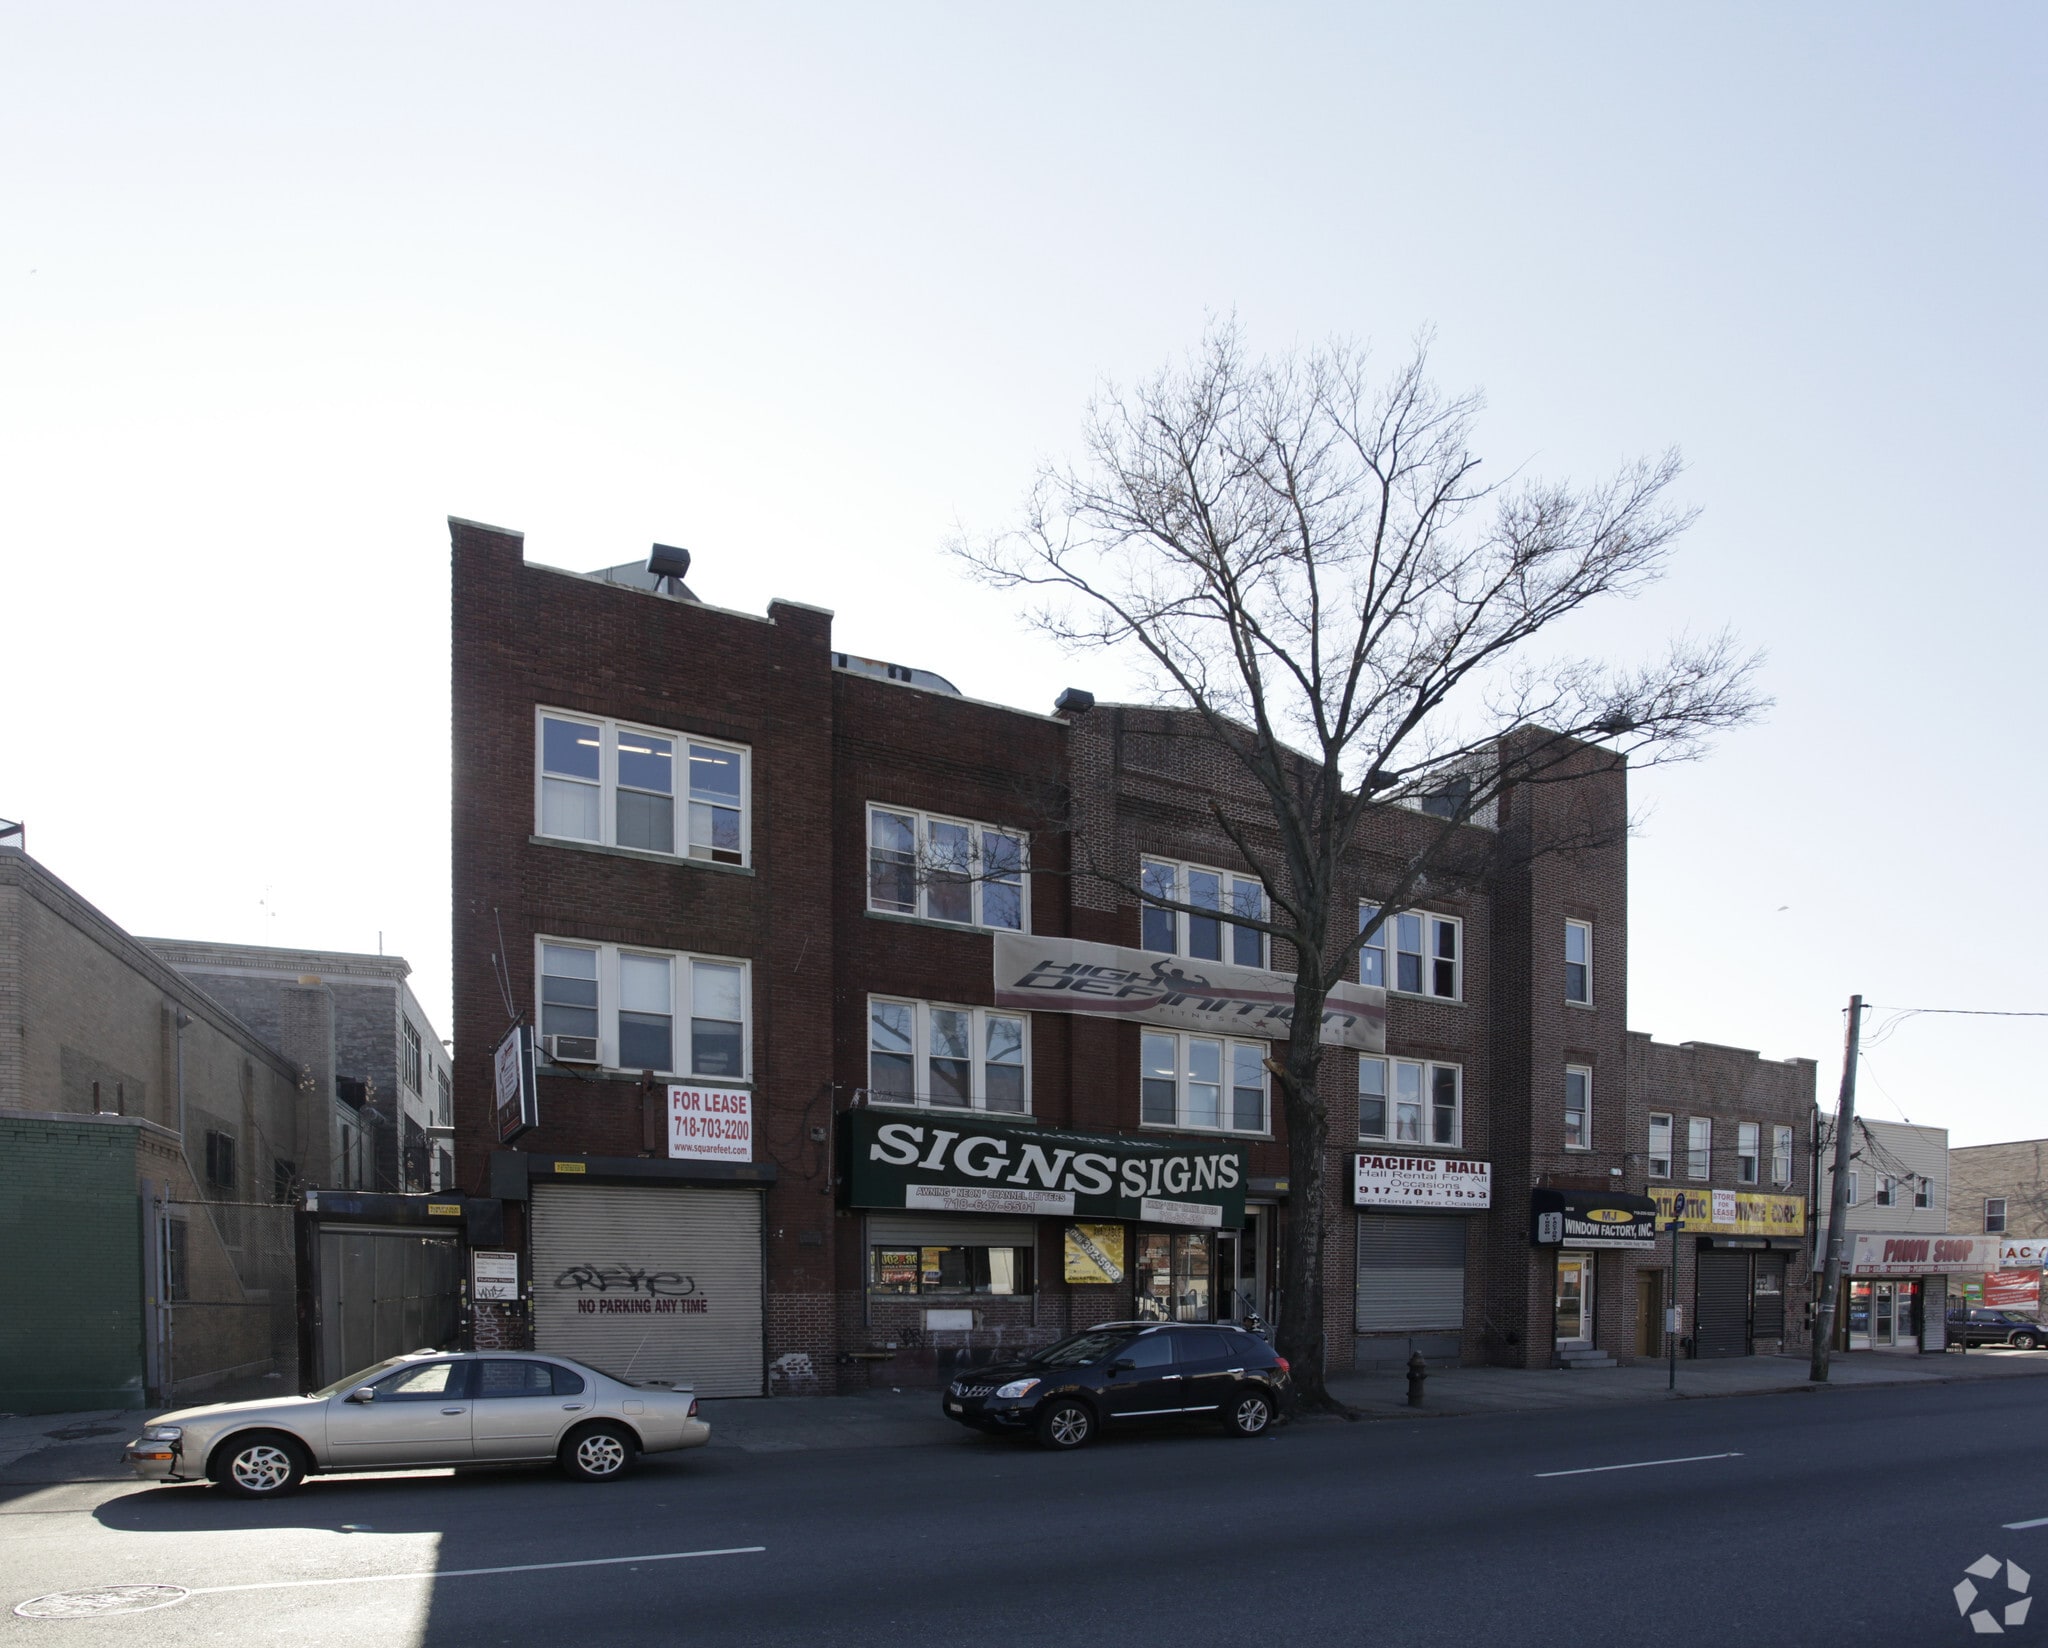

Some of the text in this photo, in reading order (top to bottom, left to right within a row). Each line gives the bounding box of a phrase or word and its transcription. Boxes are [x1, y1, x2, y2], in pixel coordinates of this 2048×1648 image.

[1032, 960, 1165, 986] HIGH
[1160, 1007, 1238, 1023] FITNESS
[673, 1091, 747, 1114] FOR LEASE
[674, 1115, 749, 1140] 718-703-2200
[674, 1143, 748, 1155] www.squarefeet.com
[869, 1123, 1240, 1199] SIGNS SIGNS
[1359, 1156, 1487, 1175] PACIFIC HALL
[1359, 1169, 1487, 1183] Hall Rental For All
[1390, 1179, 1460, 1190] Occasions
[916, 1187, 1066, 1202] AWNING NEON CHANNEL LETTERS
[1359, 1186, 1487, 1199] 917-701-1953
[1713, 1193, 1735, 1202] STORE
[943, 1198, 1036, 1213] 718-647-5501
[1378, 1197, 1412, 1205] Renta
[1416, 1198, 1442, 1206] Para
[1445, 1199, 1487, 1207] Ocasion
[1656, 1197, 1707, 1219] ATLNTIC
[1602, 1211, 1617, 1221] MJ
[1713, 1208, 1734, 1217] LEASE
[1564, 1217, 1600, 1236] WINDOW
[1601, 1224, 1637, 1239] FACTORY,
[1638, 1222, 1655, 1237] INC.
[1882, 1239, 1974, 1263] PAWN SHOP
[1081, 1239, 1120, 1280] 392-5959
[578, 1299, 708, 1313] NO PARKING ANY TIME
